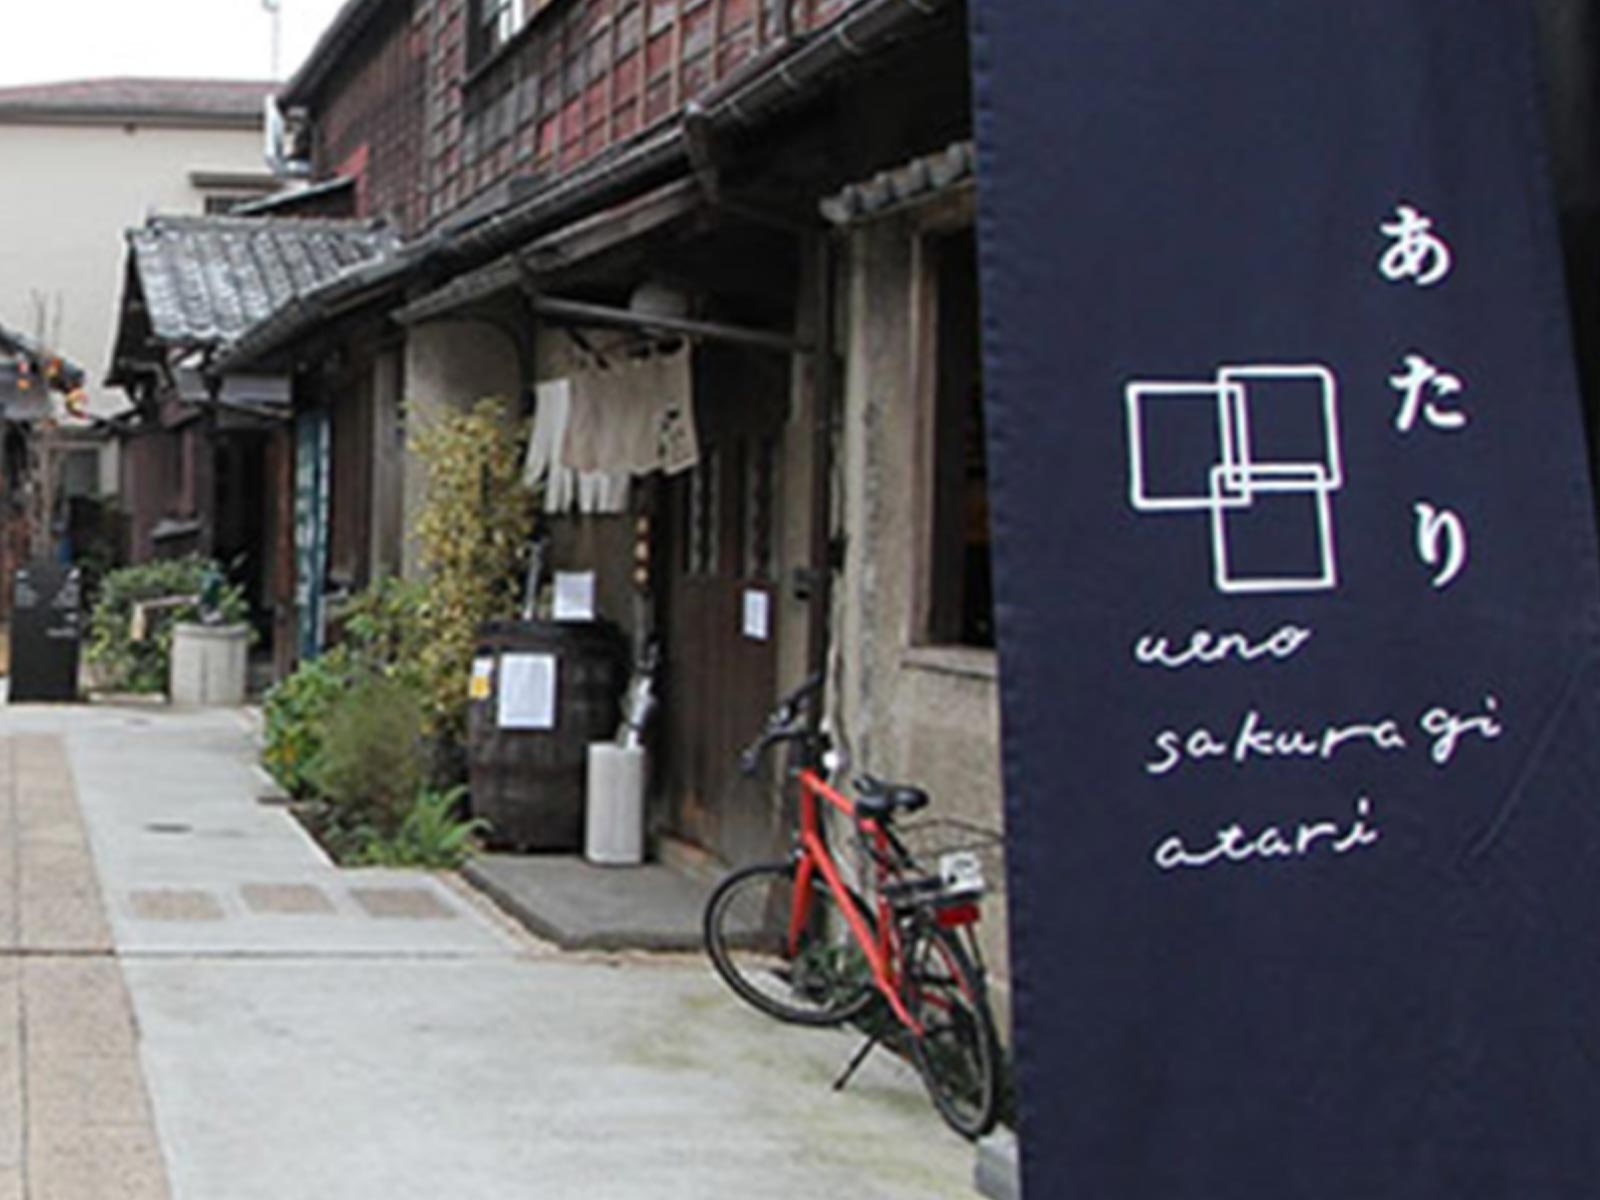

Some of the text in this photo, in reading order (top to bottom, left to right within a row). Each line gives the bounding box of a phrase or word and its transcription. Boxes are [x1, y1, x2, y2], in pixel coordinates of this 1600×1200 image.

[1378, 205, 1466, 587] あたり
[1135, 625, 1310, 667] ueno
[1154, 798, 1377, 868] atari
